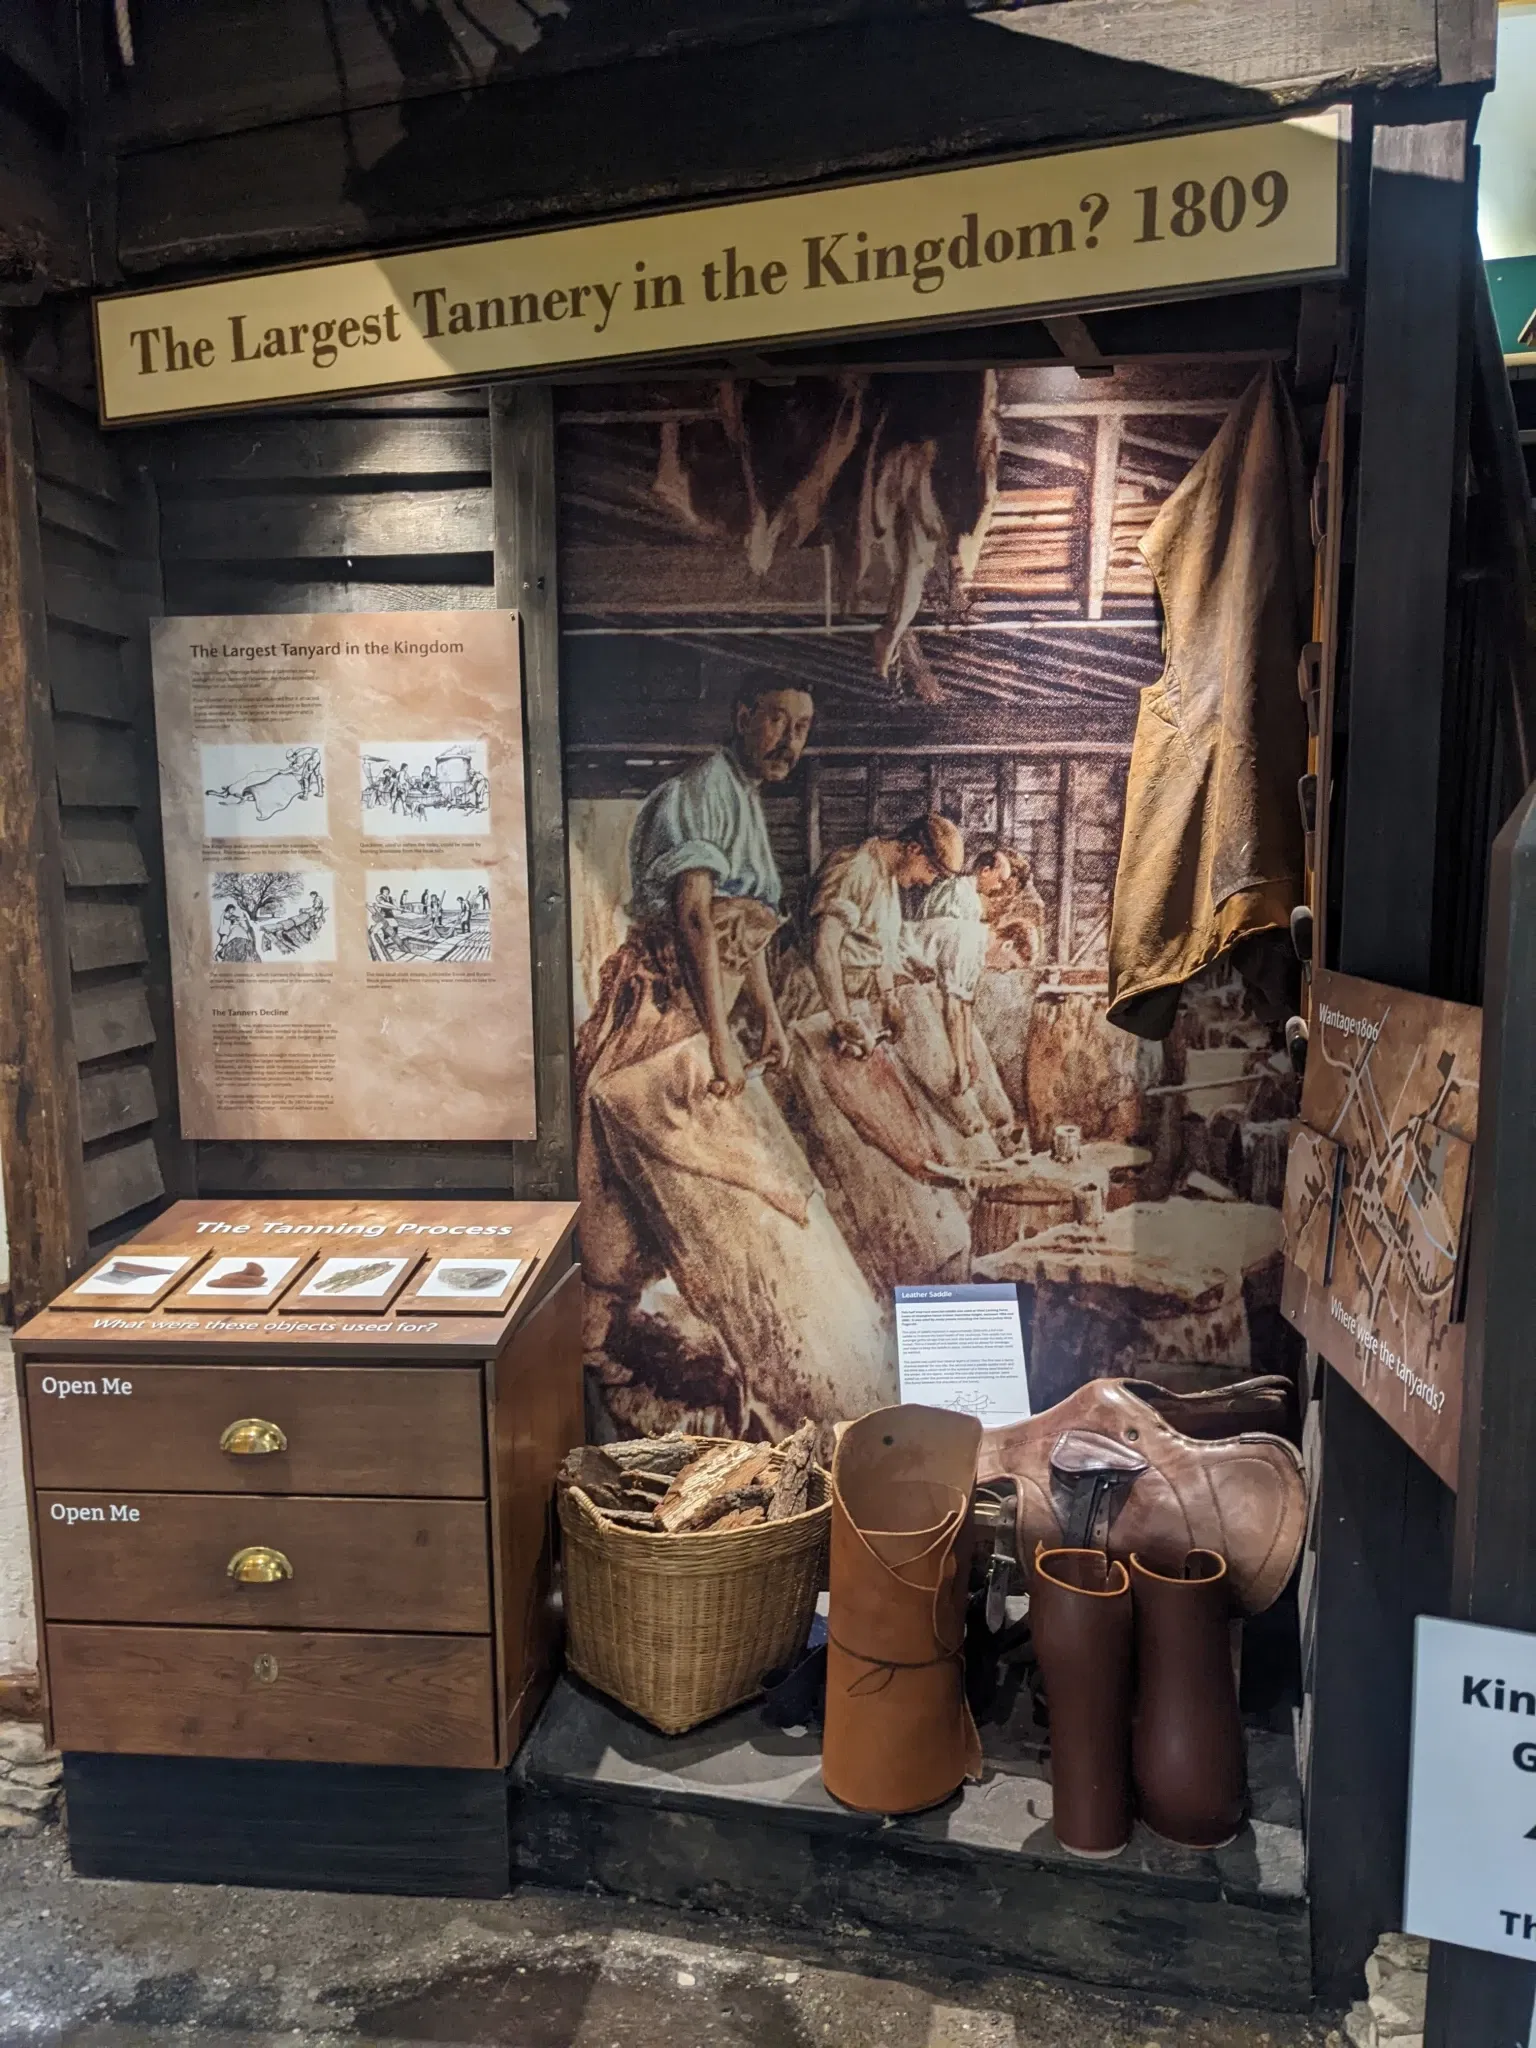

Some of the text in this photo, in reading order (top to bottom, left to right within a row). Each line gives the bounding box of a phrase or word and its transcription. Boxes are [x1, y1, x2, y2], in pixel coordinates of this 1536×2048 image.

[130, 169, 1289, 376] The Largest Tannery in the Kingdom? 1809
[190, 639, 464, 660] The Largest Tanyard in the Kingdom
[212, 1008, 289, 1016] The Tanners Decline
[1320, 1003, 1379, 1041] Wantage 1806
[195, 1221, 513, 1237] The Tanning Process
[901, 1290, 953, 1299] Leather Saddle
[92, 1318, 439, 1334] What were these objects used for?
[1331, 1295, 1445, 1415] Where were the tanyards?
[42, 1376, 132, 1398] Open Me
[50, 1503, 140, 1525] Open Me
